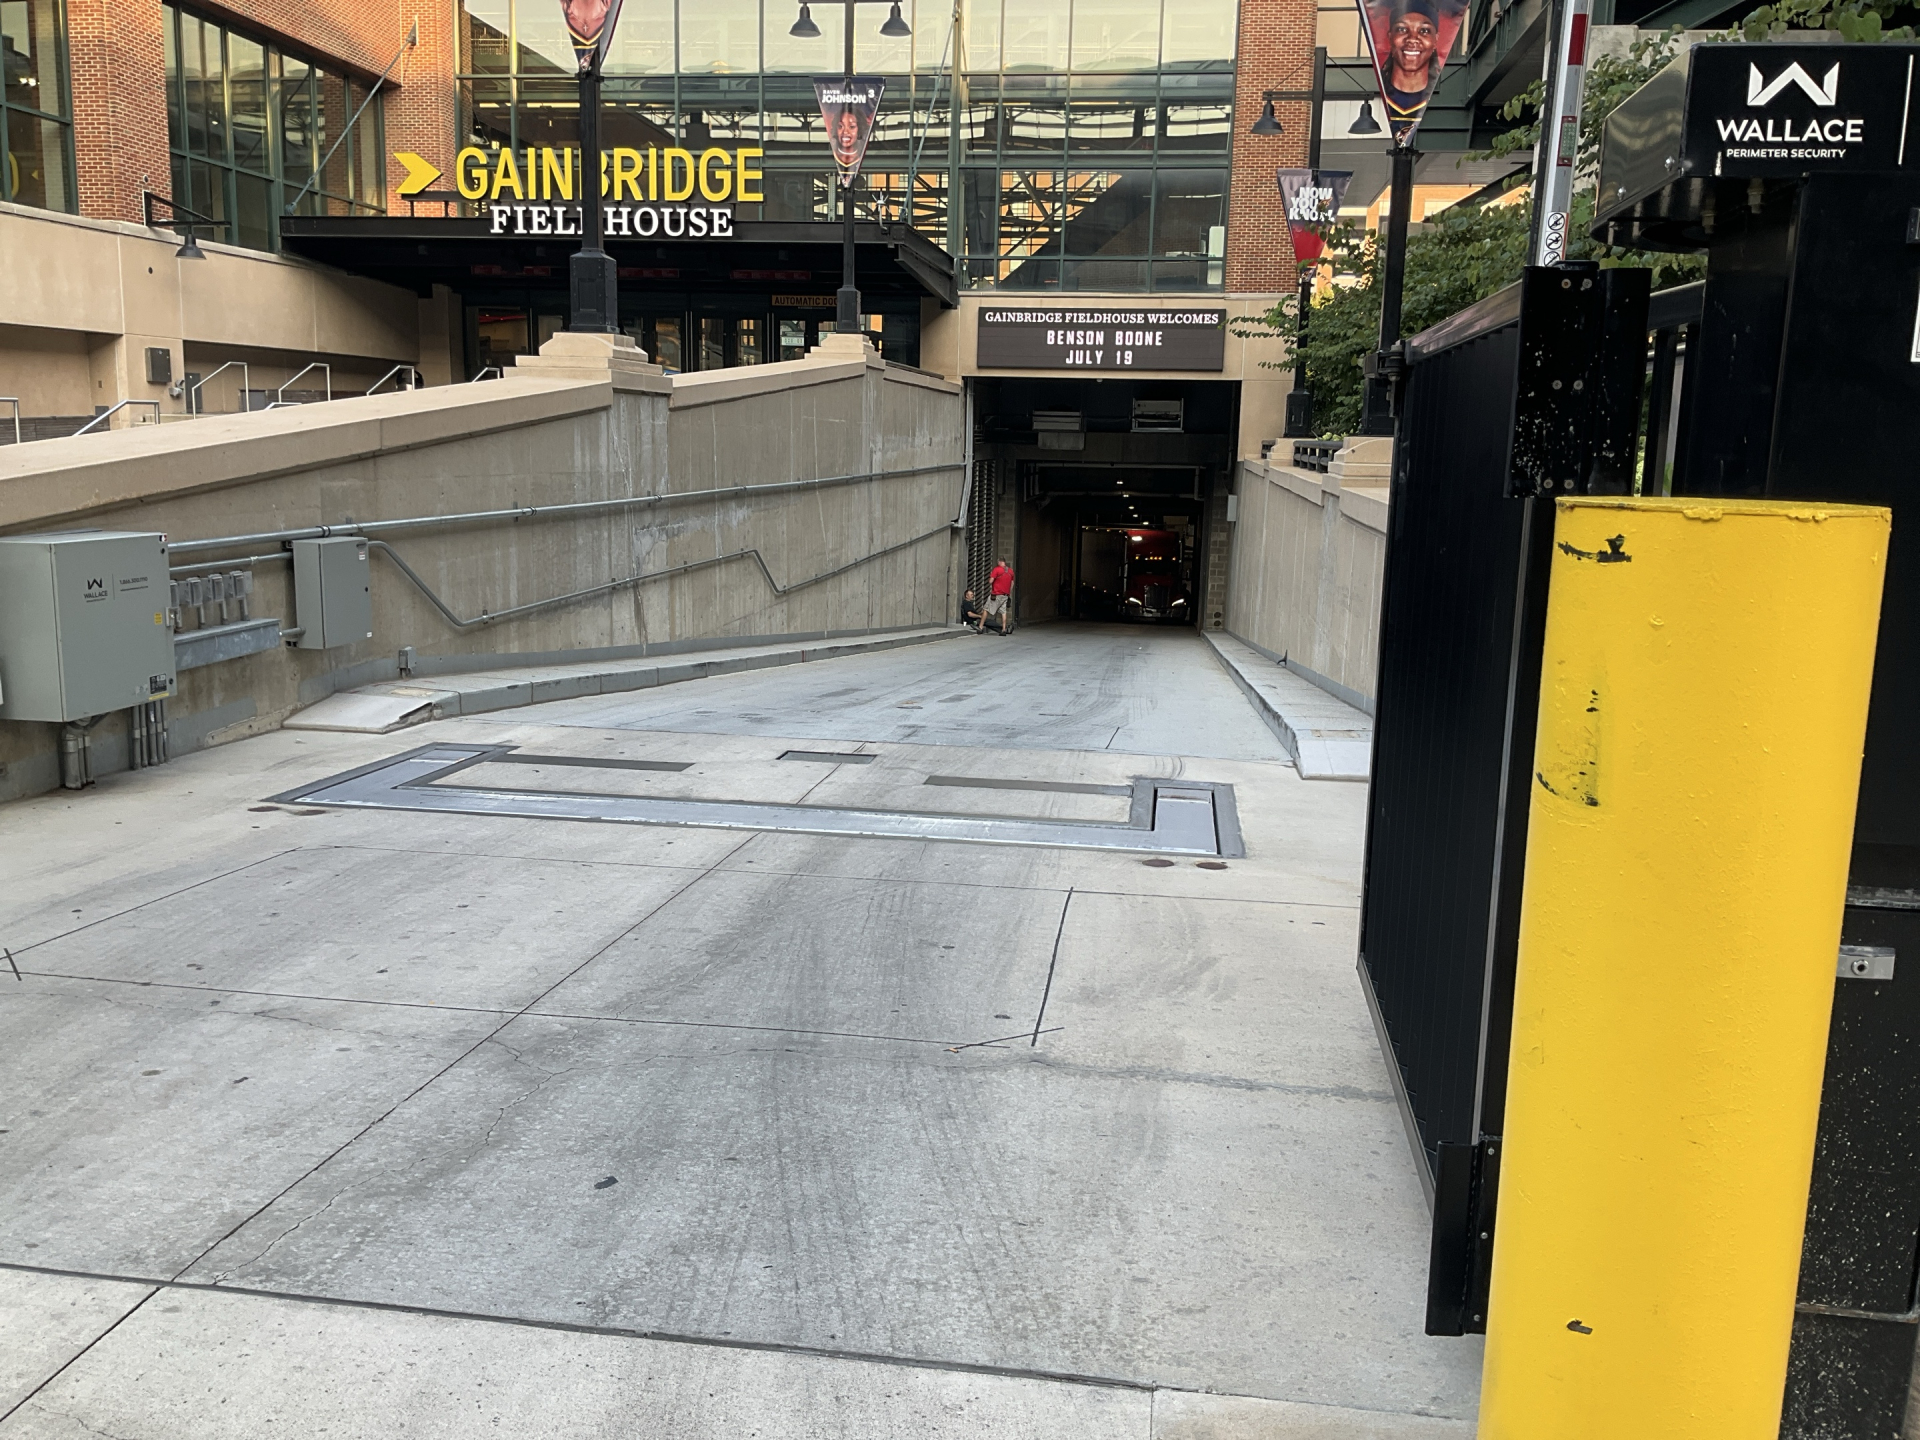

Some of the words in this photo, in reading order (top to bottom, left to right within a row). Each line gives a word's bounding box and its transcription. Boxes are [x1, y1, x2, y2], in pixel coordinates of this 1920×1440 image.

[821, 94, 867, 104] JOHNSON
[868, 89, 875, 98] 3
[1716, 119, 1864, 142] WALLACE
[1726, 148, 1788, 158] PERIMETER
[1790, 148, 1847, 159] SECURITY
[1299, 186, 1333, 200] NOW
[1290, 197, 1319, 210] YOU
[489, 205, 734, 237] FIELHOUSE
[774, 296, 820, 306] AUTOMATIC
[985, 311, 1063, 323] GAINBRIDGE
[1065, 313, 1145, 324] FIELDHOUSE
[1147, 313, 1219, 325] WELCOMES
[1046, 330, 1105, 345] BENSON
[1115, 331, 1163, 346] BOONE
[1065, 350, 1104, 365] JULY
[1116, 351, 1133, 365] 19
[84, 590, 108, 598] WALLACE
